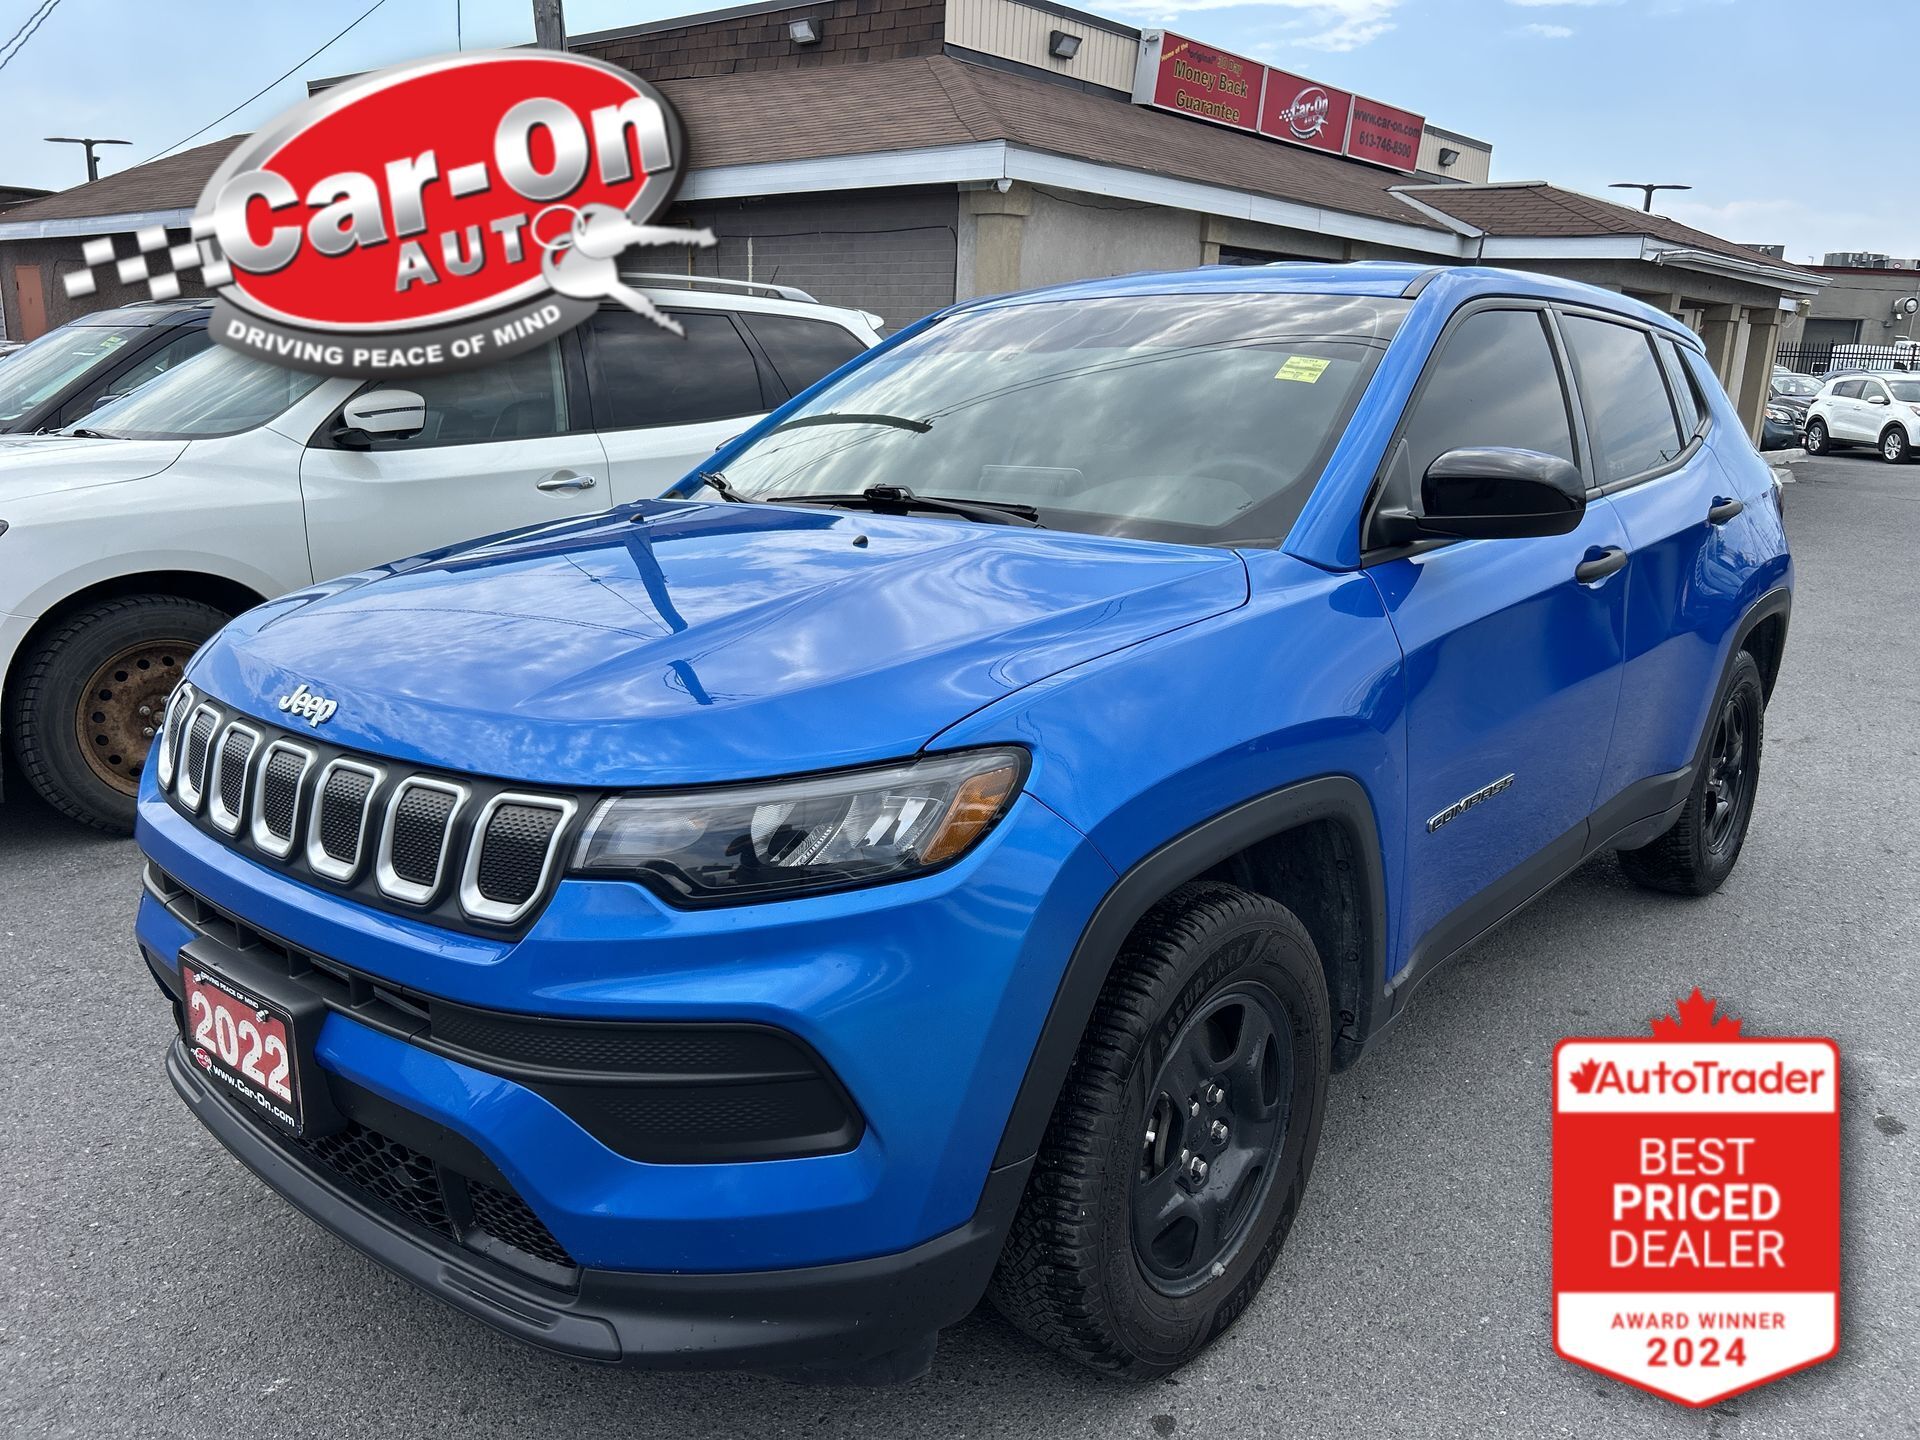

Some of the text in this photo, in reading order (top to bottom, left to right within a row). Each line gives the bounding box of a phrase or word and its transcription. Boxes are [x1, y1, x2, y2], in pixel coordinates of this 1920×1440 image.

[1173, 58, 1249, 99] Money Back
[1175, 88, 1241, 123] Guarantee
[1354, 108, 1422, 137] www.car-on.com
[279, 684, 338, 728] Jeep
[1427, 773, 1515, 833] COMPASS
[191, 990, 292, 1103] 2022
[213, 1065, 295, 1127] www.Car-On.com
